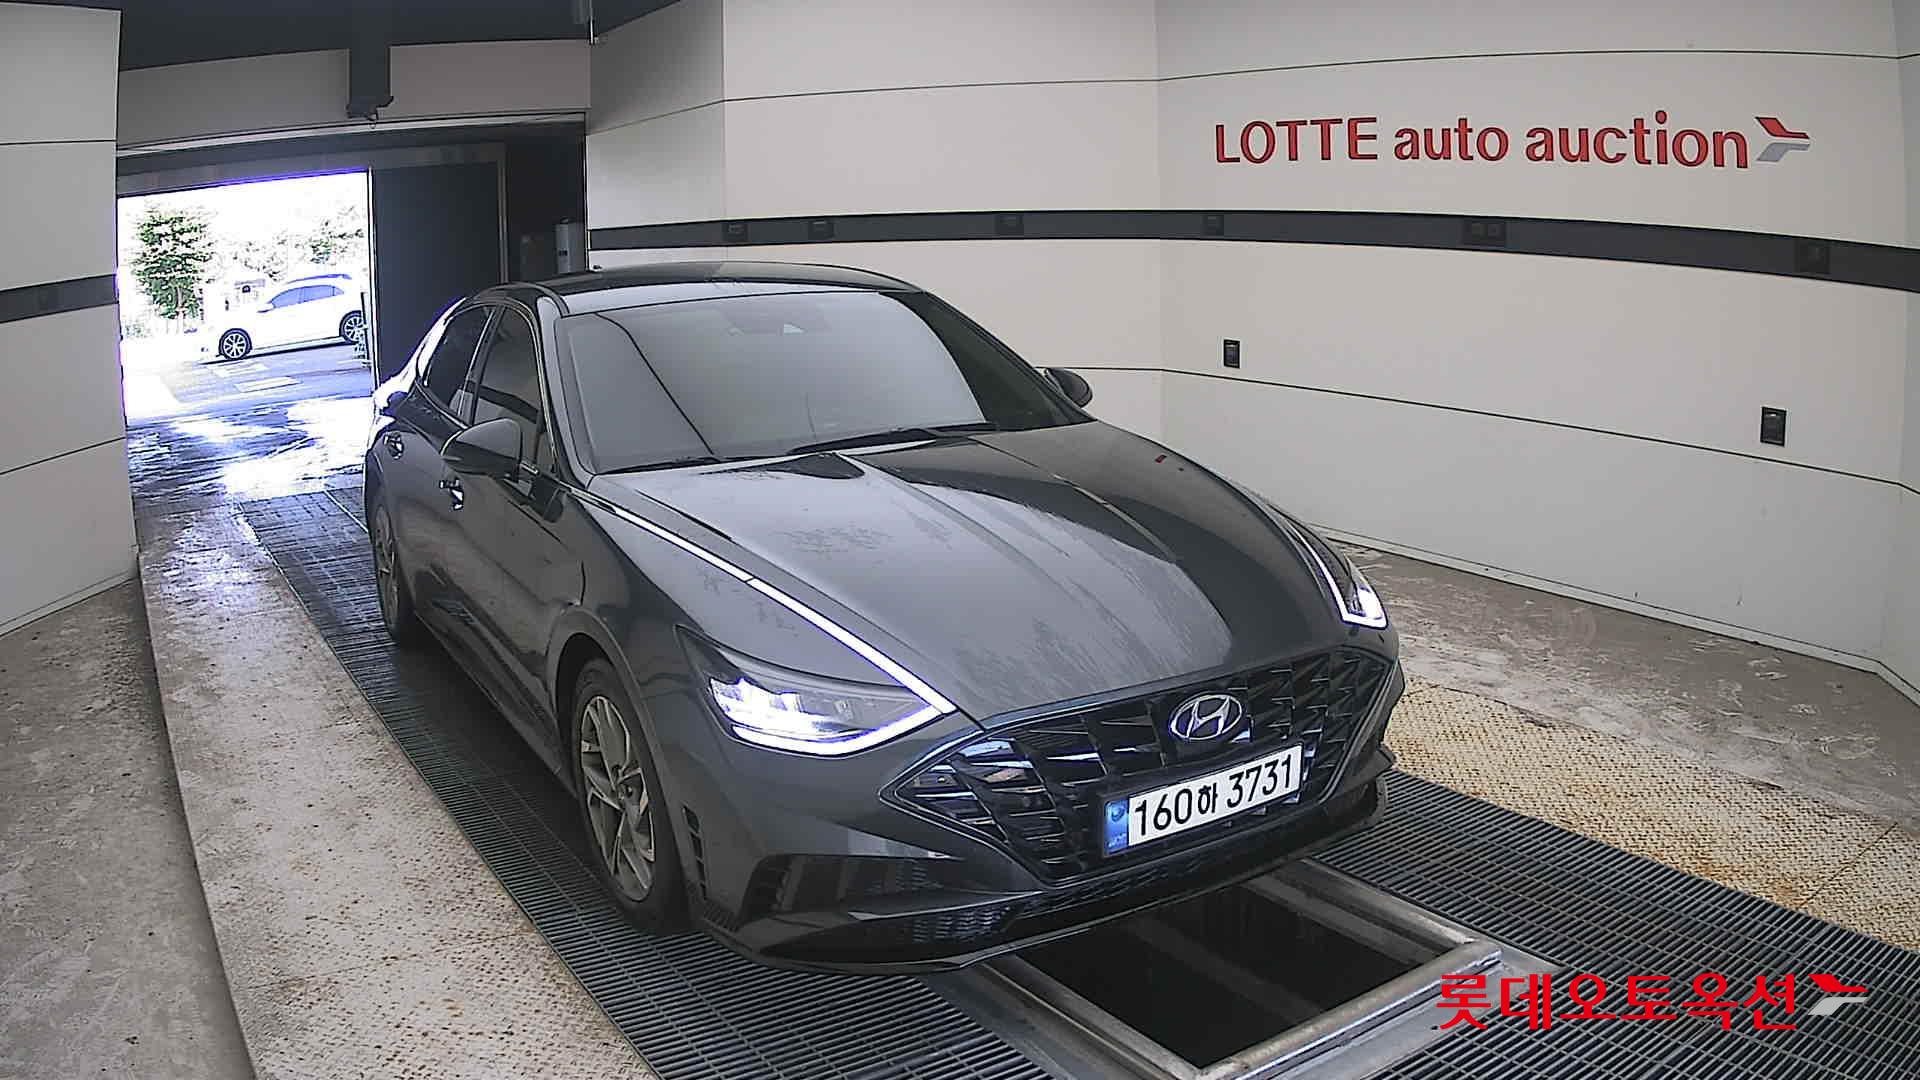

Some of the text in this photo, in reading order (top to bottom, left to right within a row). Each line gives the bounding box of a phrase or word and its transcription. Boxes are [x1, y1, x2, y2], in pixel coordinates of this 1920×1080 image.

[1215, 110, 1750, 170] LOTTE auto auction
[1134, 754, 1292, 836] 160하 3731
